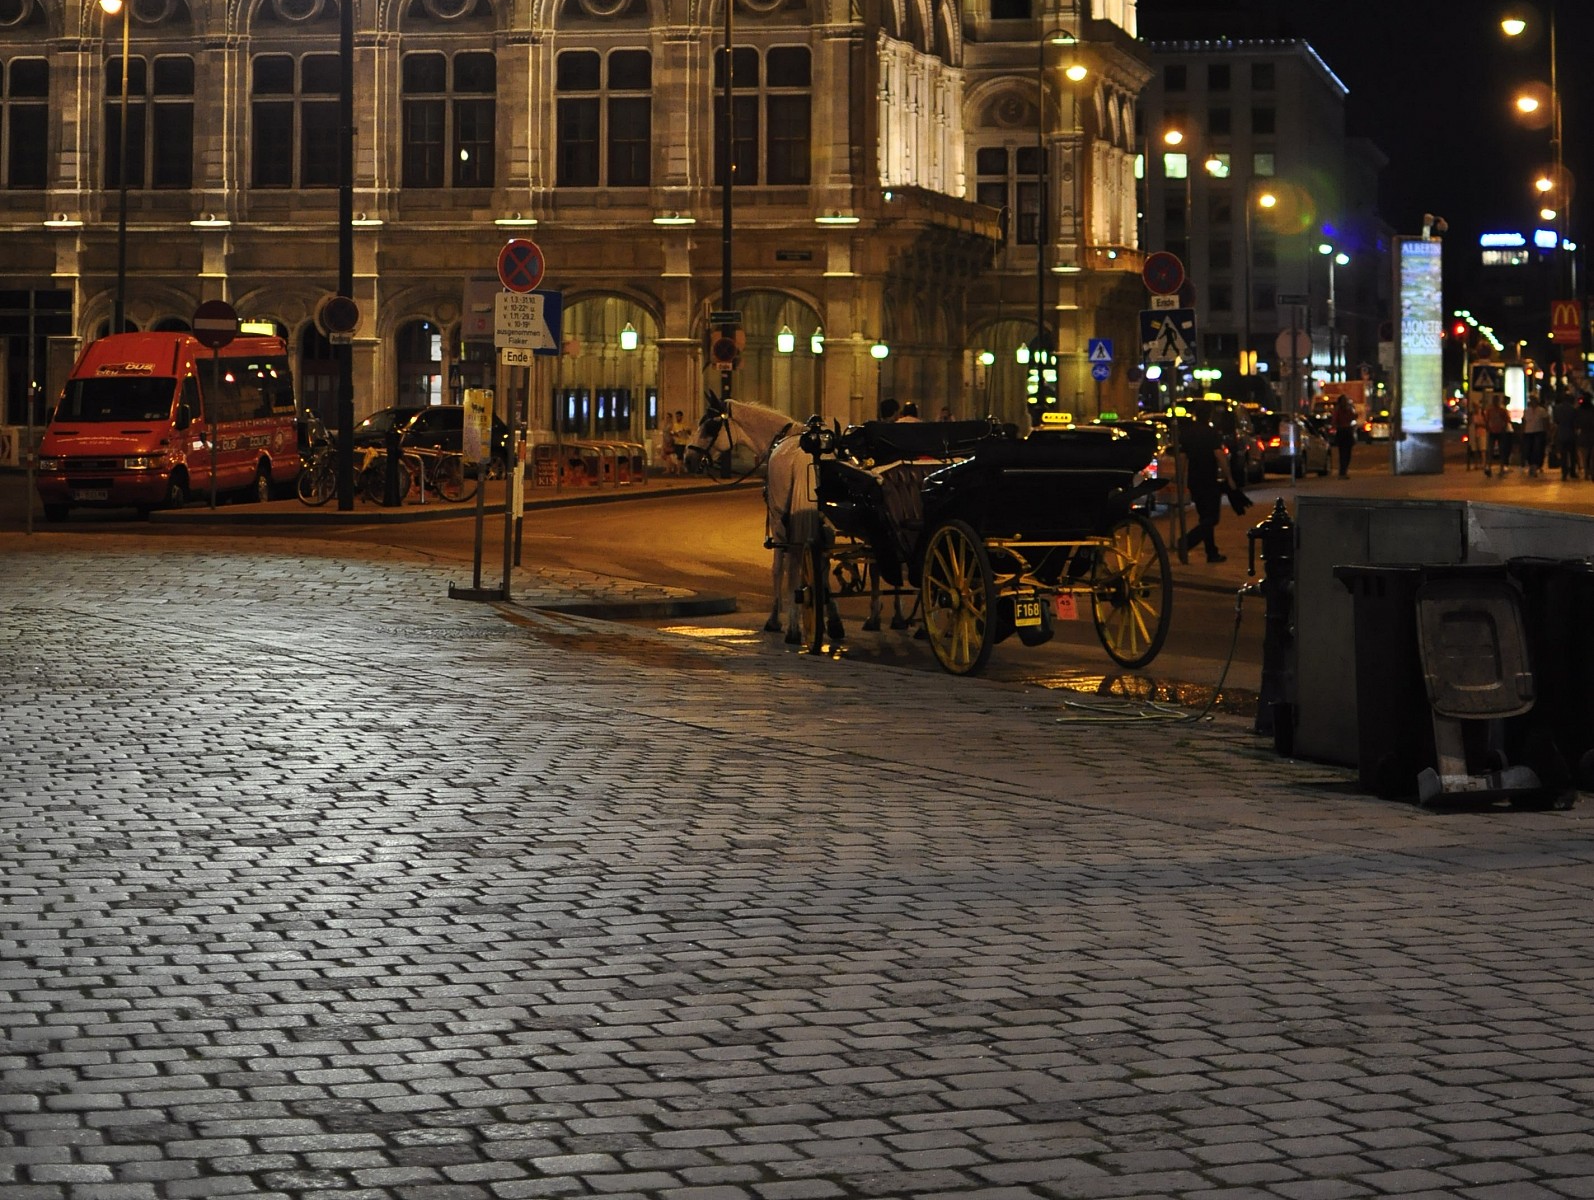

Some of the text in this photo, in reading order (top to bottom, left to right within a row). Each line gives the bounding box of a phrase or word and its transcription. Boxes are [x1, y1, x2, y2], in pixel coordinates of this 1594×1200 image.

[496, 329, 541, 337] ausgenommen
[508, 337, 529, 345] Fiaker
[507, 351, 529, 363] Ende
[1016, 603, 1040, 617] F168
